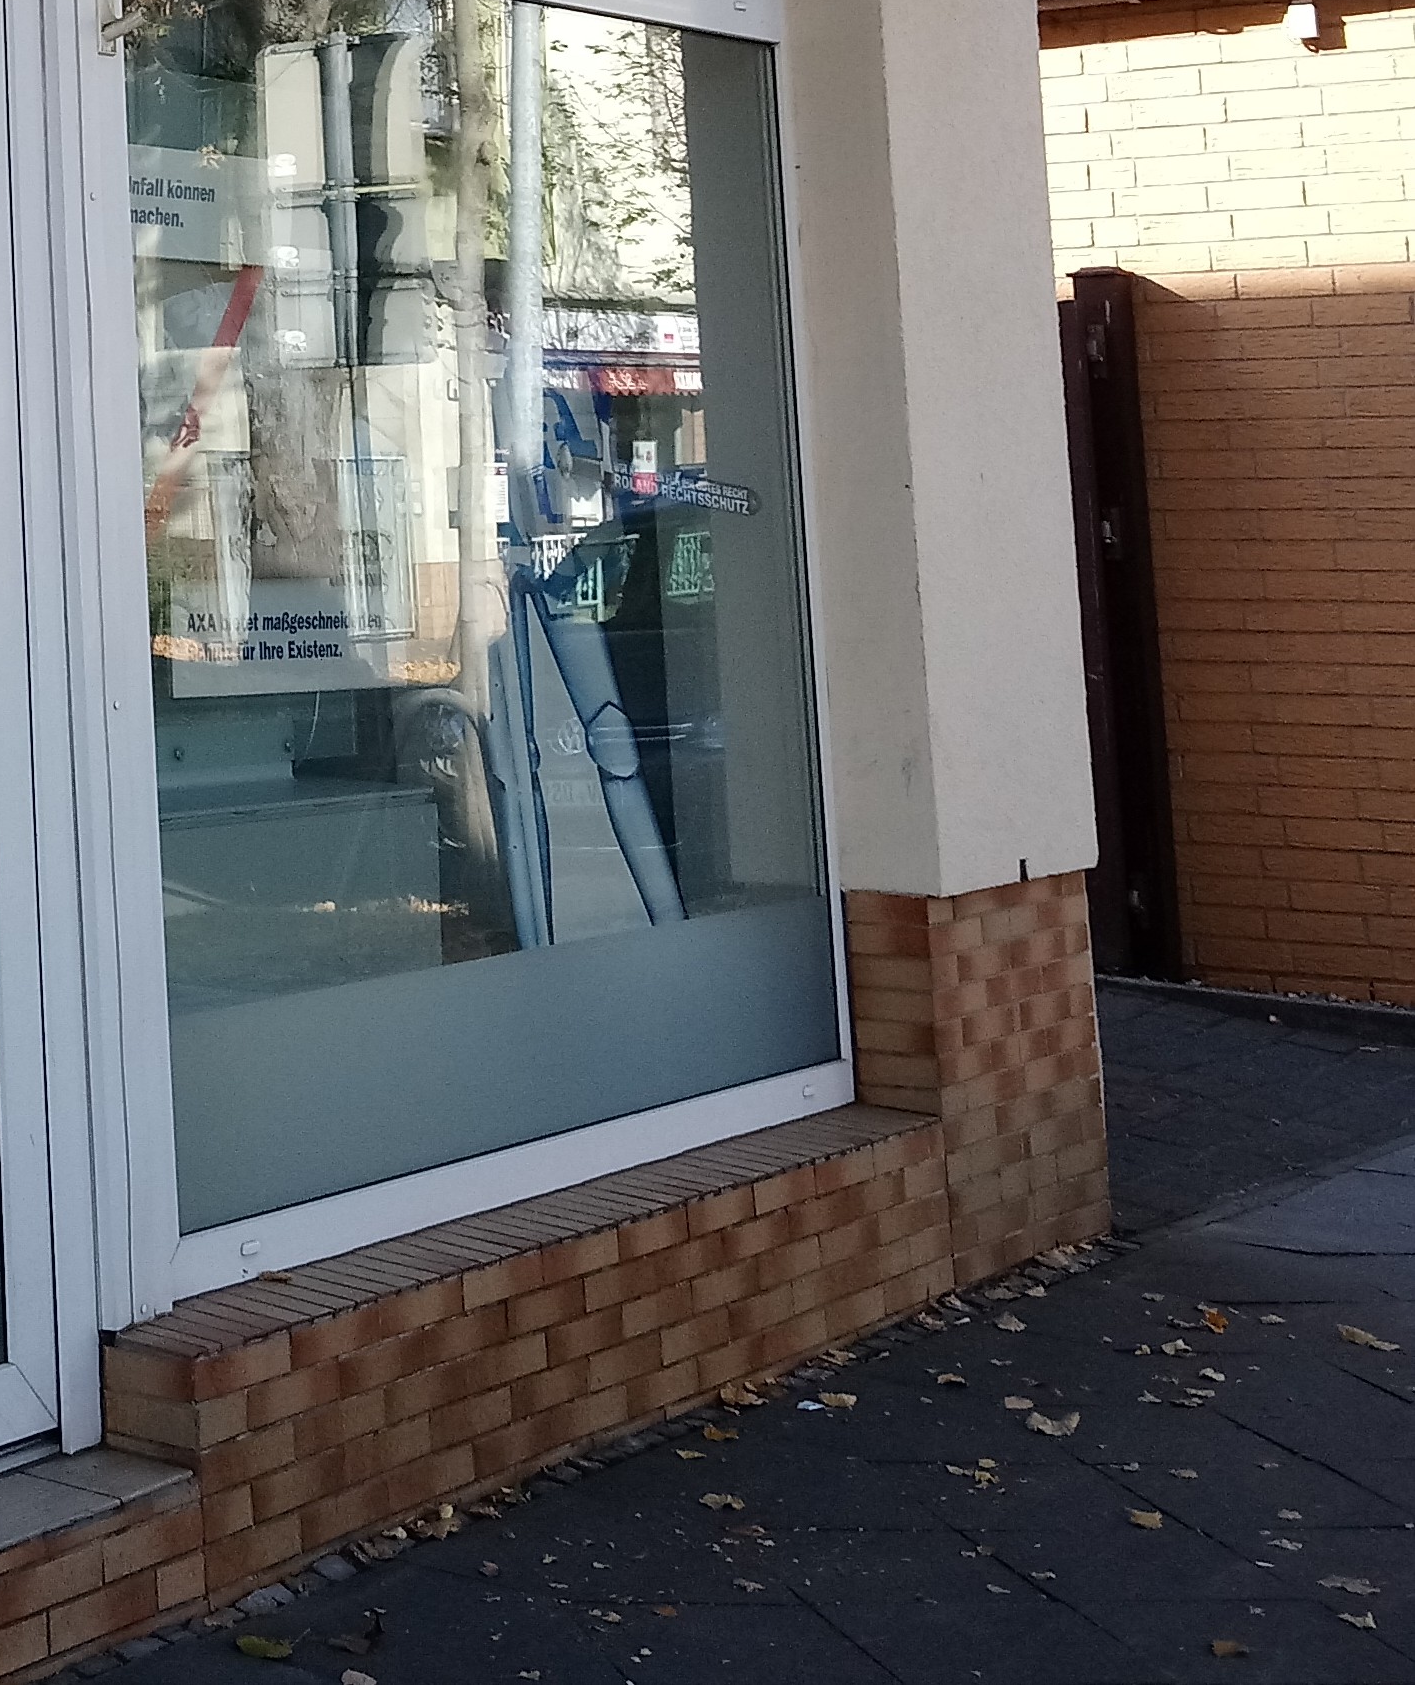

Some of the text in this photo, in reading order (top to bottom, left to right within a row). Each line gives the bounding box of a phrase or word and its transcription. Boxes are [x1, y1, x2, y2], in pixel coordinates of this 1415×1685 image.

[167, 179, 215, 202] können
[660, 485, 750, 516] RECHTSSCHUTZ
[186, 613, 217, 633] AXA
[259, 641, 284, 660] Ihre
[288, 640, 343, 660] Existenz.
